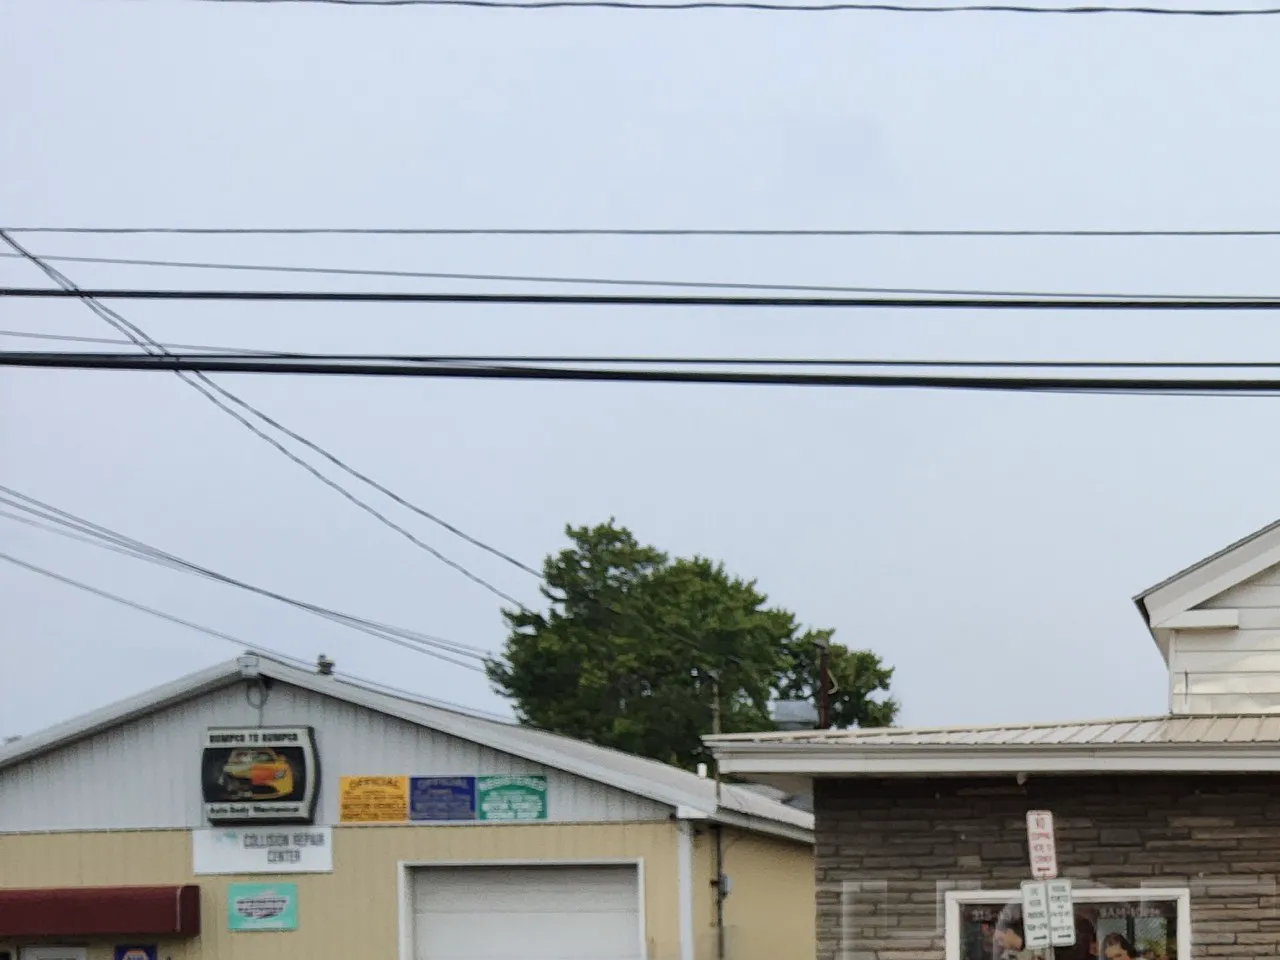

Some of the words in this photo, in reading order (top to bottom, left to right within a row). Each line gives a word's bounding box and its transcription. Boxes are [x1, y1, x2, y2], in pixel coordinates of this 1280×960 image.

[243, 833, 289, 849] COLLISION
[292, 832, 325, 846] REPAIR
[267, 850, 301, 864] CENTER
